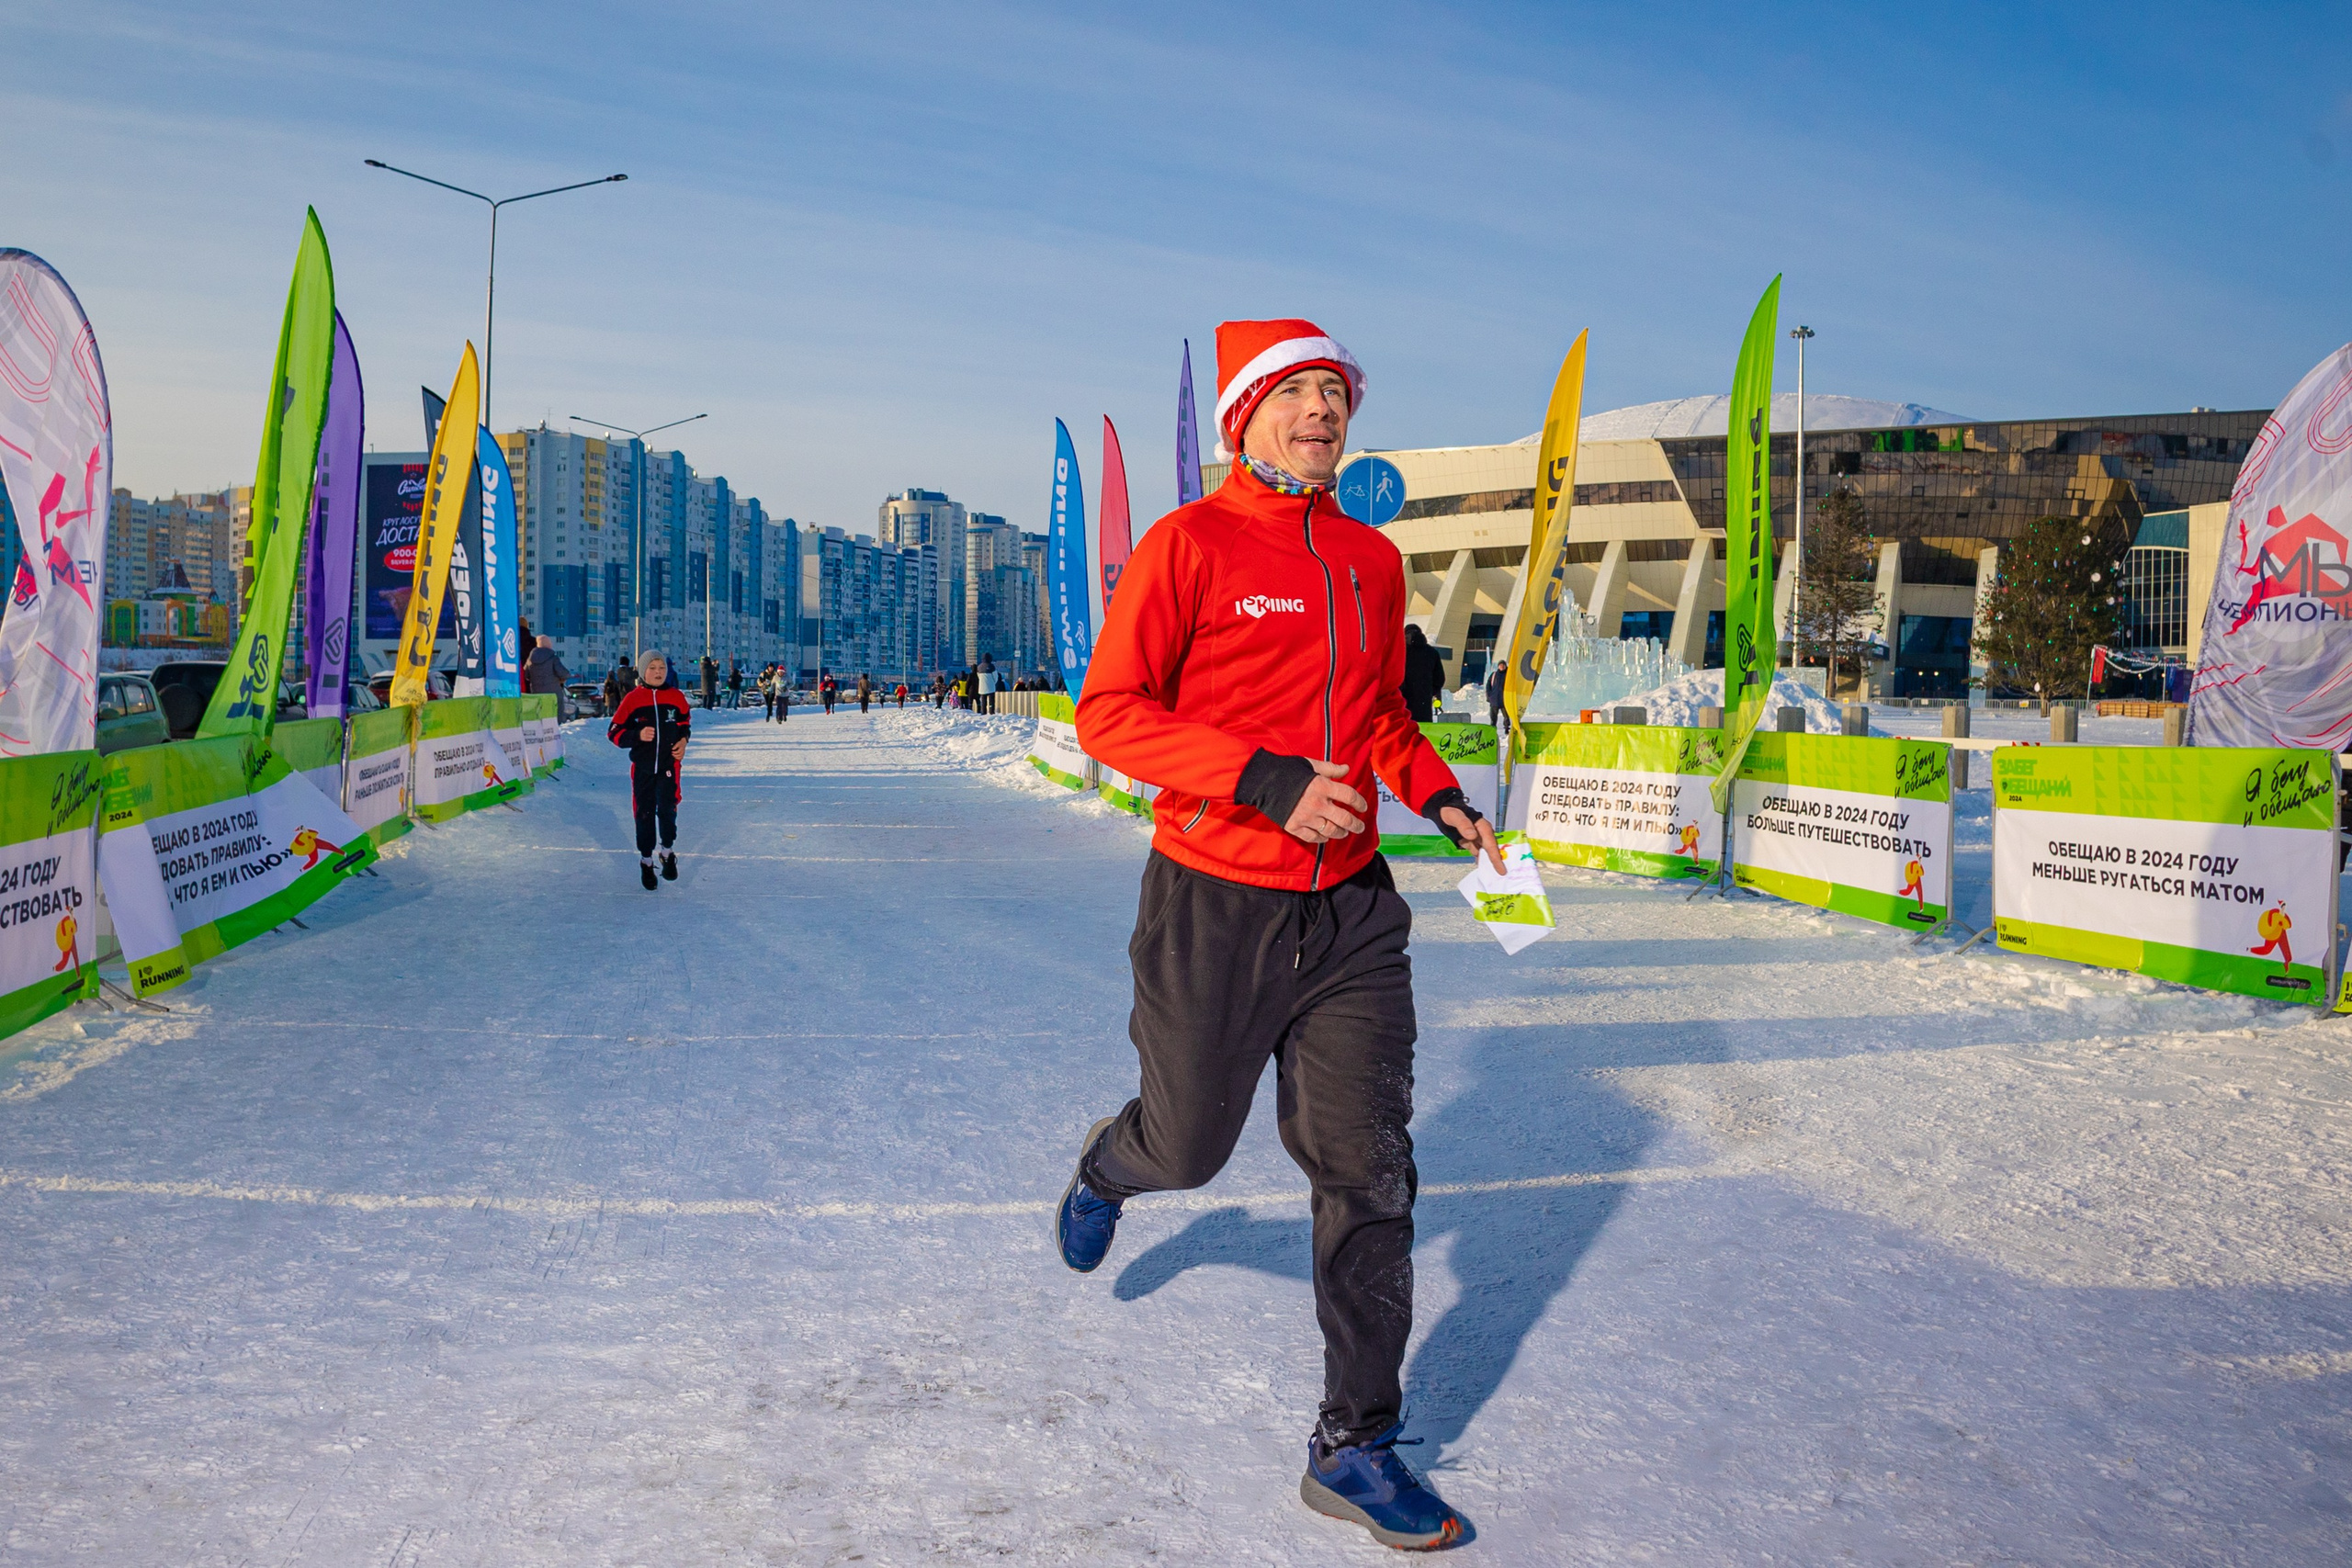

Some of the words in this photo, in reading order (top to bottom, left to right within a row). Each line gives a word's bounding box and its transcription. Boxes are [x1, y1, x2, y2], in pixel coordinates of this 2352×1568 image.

[2218, 598, 2352, 623] ЧЕМПИОН
[1541, 793, 1611, 810] СЛЕДОВАТЬ
[1615, 799, 1679, 817] ПРАВИЛУ:
[1543, 776, 1599, 792] ОБЕЩАЮ
[1600, 780, 1609, 792] В
[1612, 781, 1643, 795] 2024
[1646, 784, 1681, 800] ГОДУ
[108, 810, 133, 822] 2024
[1534, 810, 1549, 821] «Я
[1553, 812, 1570, 826] ТО,
[1575, 814, 1597, 827] ЧТО
[1601, 816, 1609, 828] Я
[1612, 817, 1629, 830] ЕМ
[1634, 818, 1642, 831] И
[1645, 820, 1682, 835] ПЬЮ»
[1763, 795, 1820, 817] ОБЕЩАЮ
[1824, 805, 1832, 818] В
[1836, 806, 1868, 824] 2024
[1870, 810, 1910, 831] ГОДУ
[152, 829, 189, 855] ЕЩАЮ
[193, 828, 200, 844] В
[202, 821, 230, 840] 2024
[232, 809, 258, 832] ГОДУ
[1747, 814, 1795, 836] БОЛЬШЕ
[1798, 823, 1932, 858] ПУТЕШЕСТВОВАТЬ
[0, 866, 18, 895] 24
[23, 855, 62, 887] ГОДУ
[161, 855, 209, 882] ДОВАТЬ
[211, 833, 272, 863] ПРАВИЛУ:
[2049, 840, 2120, 863] ОБЕЩАЮ
[2126, 848, 2136, 864] В
[2141, 850, 2184, 869] 2024
[2189, 853, 2239, 877] ГОДУ
[175, 883, 198, 904] ЧТО
[201, 877, 209, 896] Я
[212, 874, 228, 893] ЕМ
[230, 866, 239, 886] И
[241, 848, 294, 882] ПЬЮ»
[2032, 862, 2097, 885] МЕНЬШЕ
[2099, 870, 2185, 897] РУГАТЬСЯ
[2191, 880, 2265, 906] МАТОМ
[0, 886, 83, 930] СТВОВАТЬ
[138, 968, 143, 978] I
[140, 964, 185, 989] RUNNING
